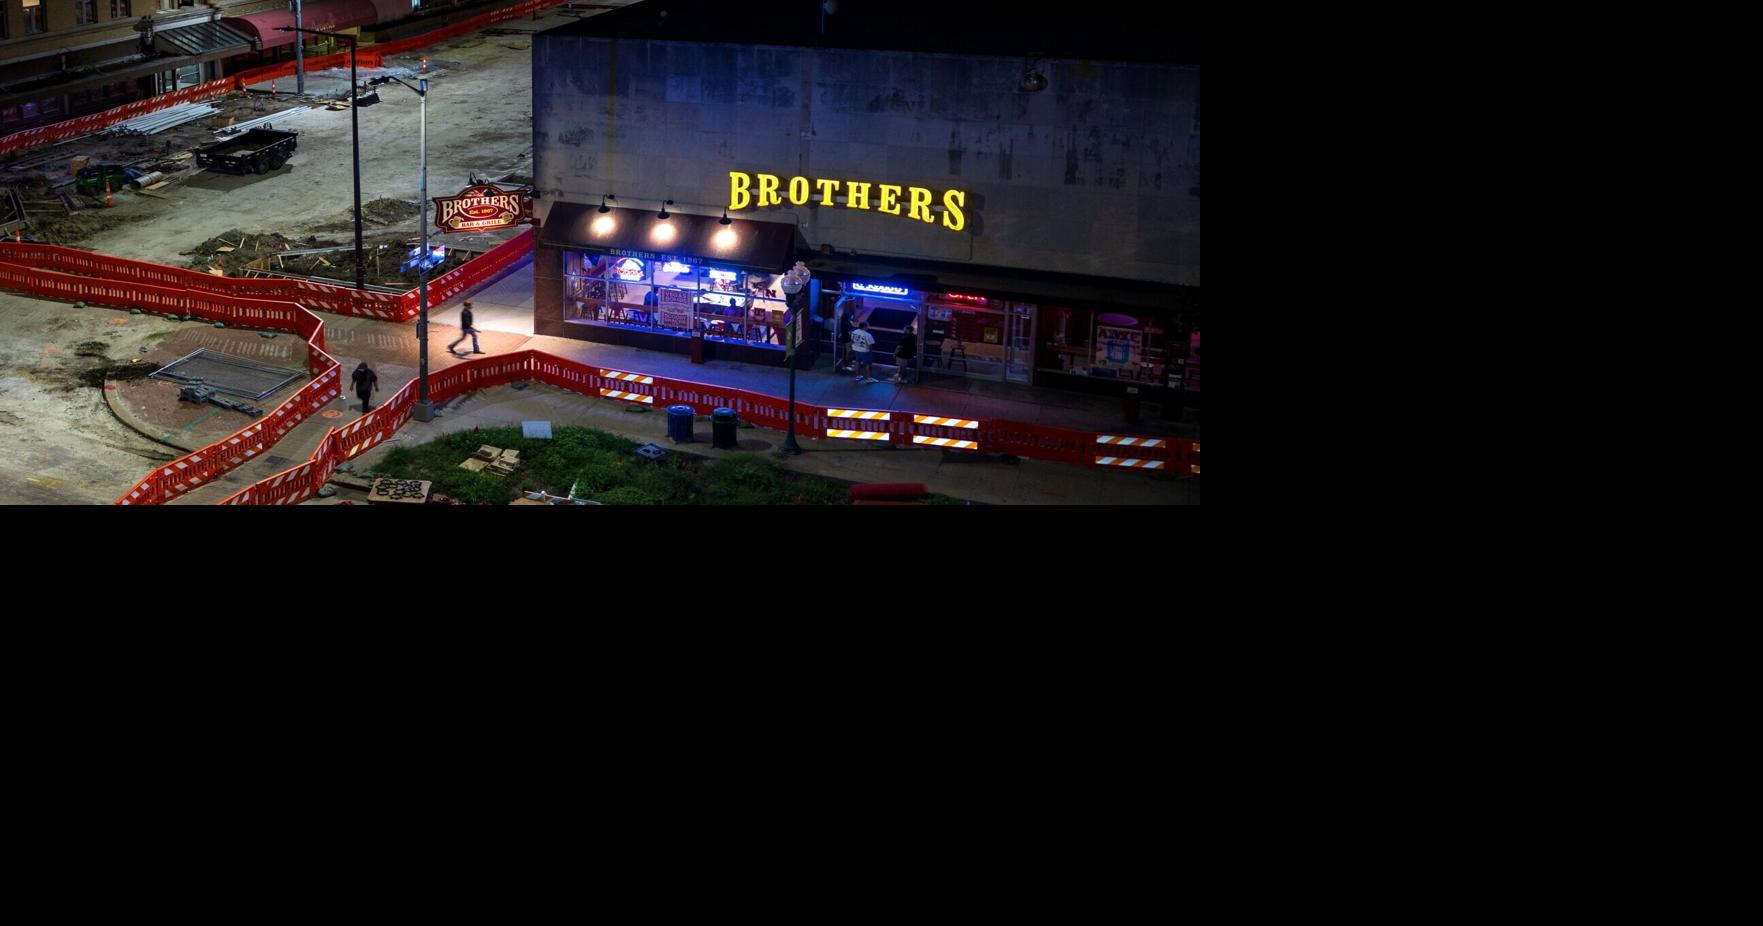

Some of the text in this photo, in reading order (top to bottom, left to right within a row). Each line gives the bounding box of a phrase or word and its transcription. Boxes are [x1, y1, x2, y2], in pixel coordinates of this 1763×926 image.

[442, 195, 519, 223] BROTHERS
[728, 171, 965, 231] BROTHERS
[609, 248, 656, 259] BROTHERS
